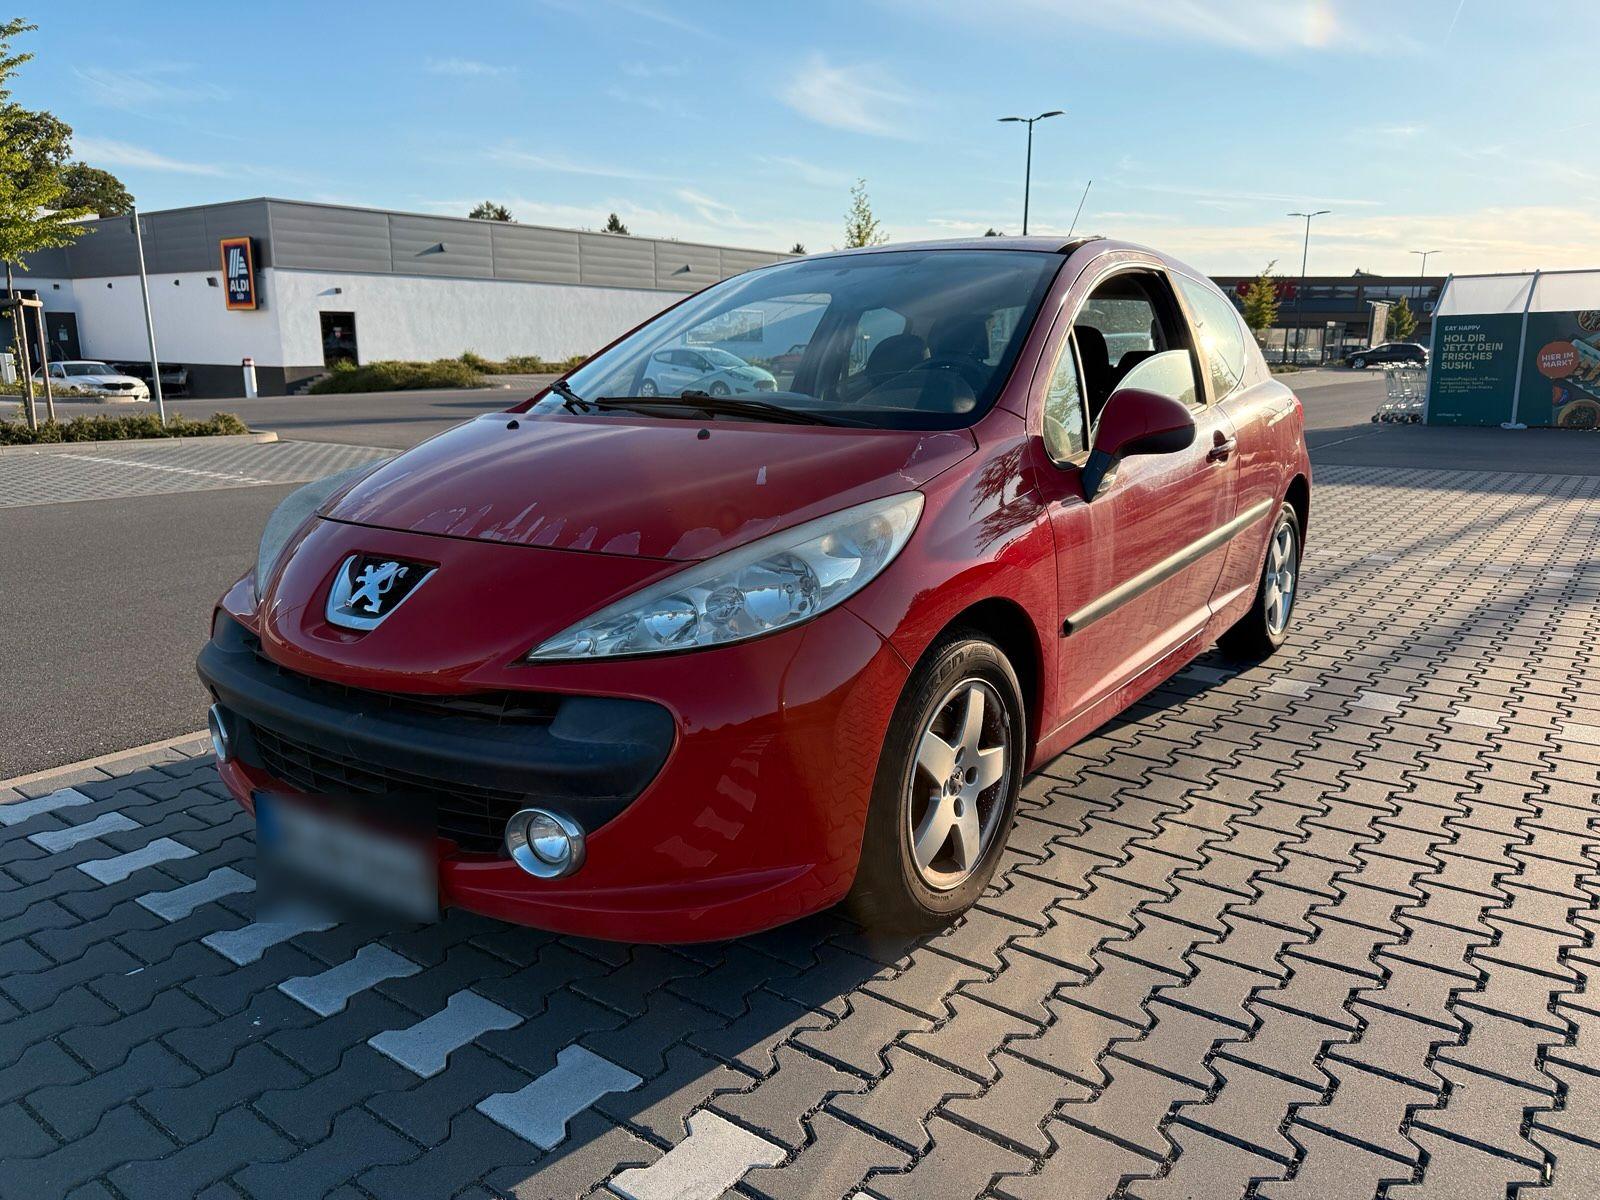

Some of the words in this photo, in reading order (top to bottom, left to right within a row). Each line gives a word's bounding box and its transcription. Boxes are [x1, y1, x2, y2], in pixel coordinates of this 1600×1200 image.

[230, 279, 249, 291] ALDI
[1443, 334, 1466, 343] HOL
[1467, 334, 1486, 342] DIR
[1442, 343, 1475, 352] JETZT
[1477, 342, 1504, 351] DEIN
[1441, 352, 1493, 361] FRISCHES
[1541, 353, 1561, 361] HIER
[1563, 351, 1574, 359] IM
[1441, 361, 1475, 370] SUSHI.
[1543, 359, 1574, 369] MARKT
